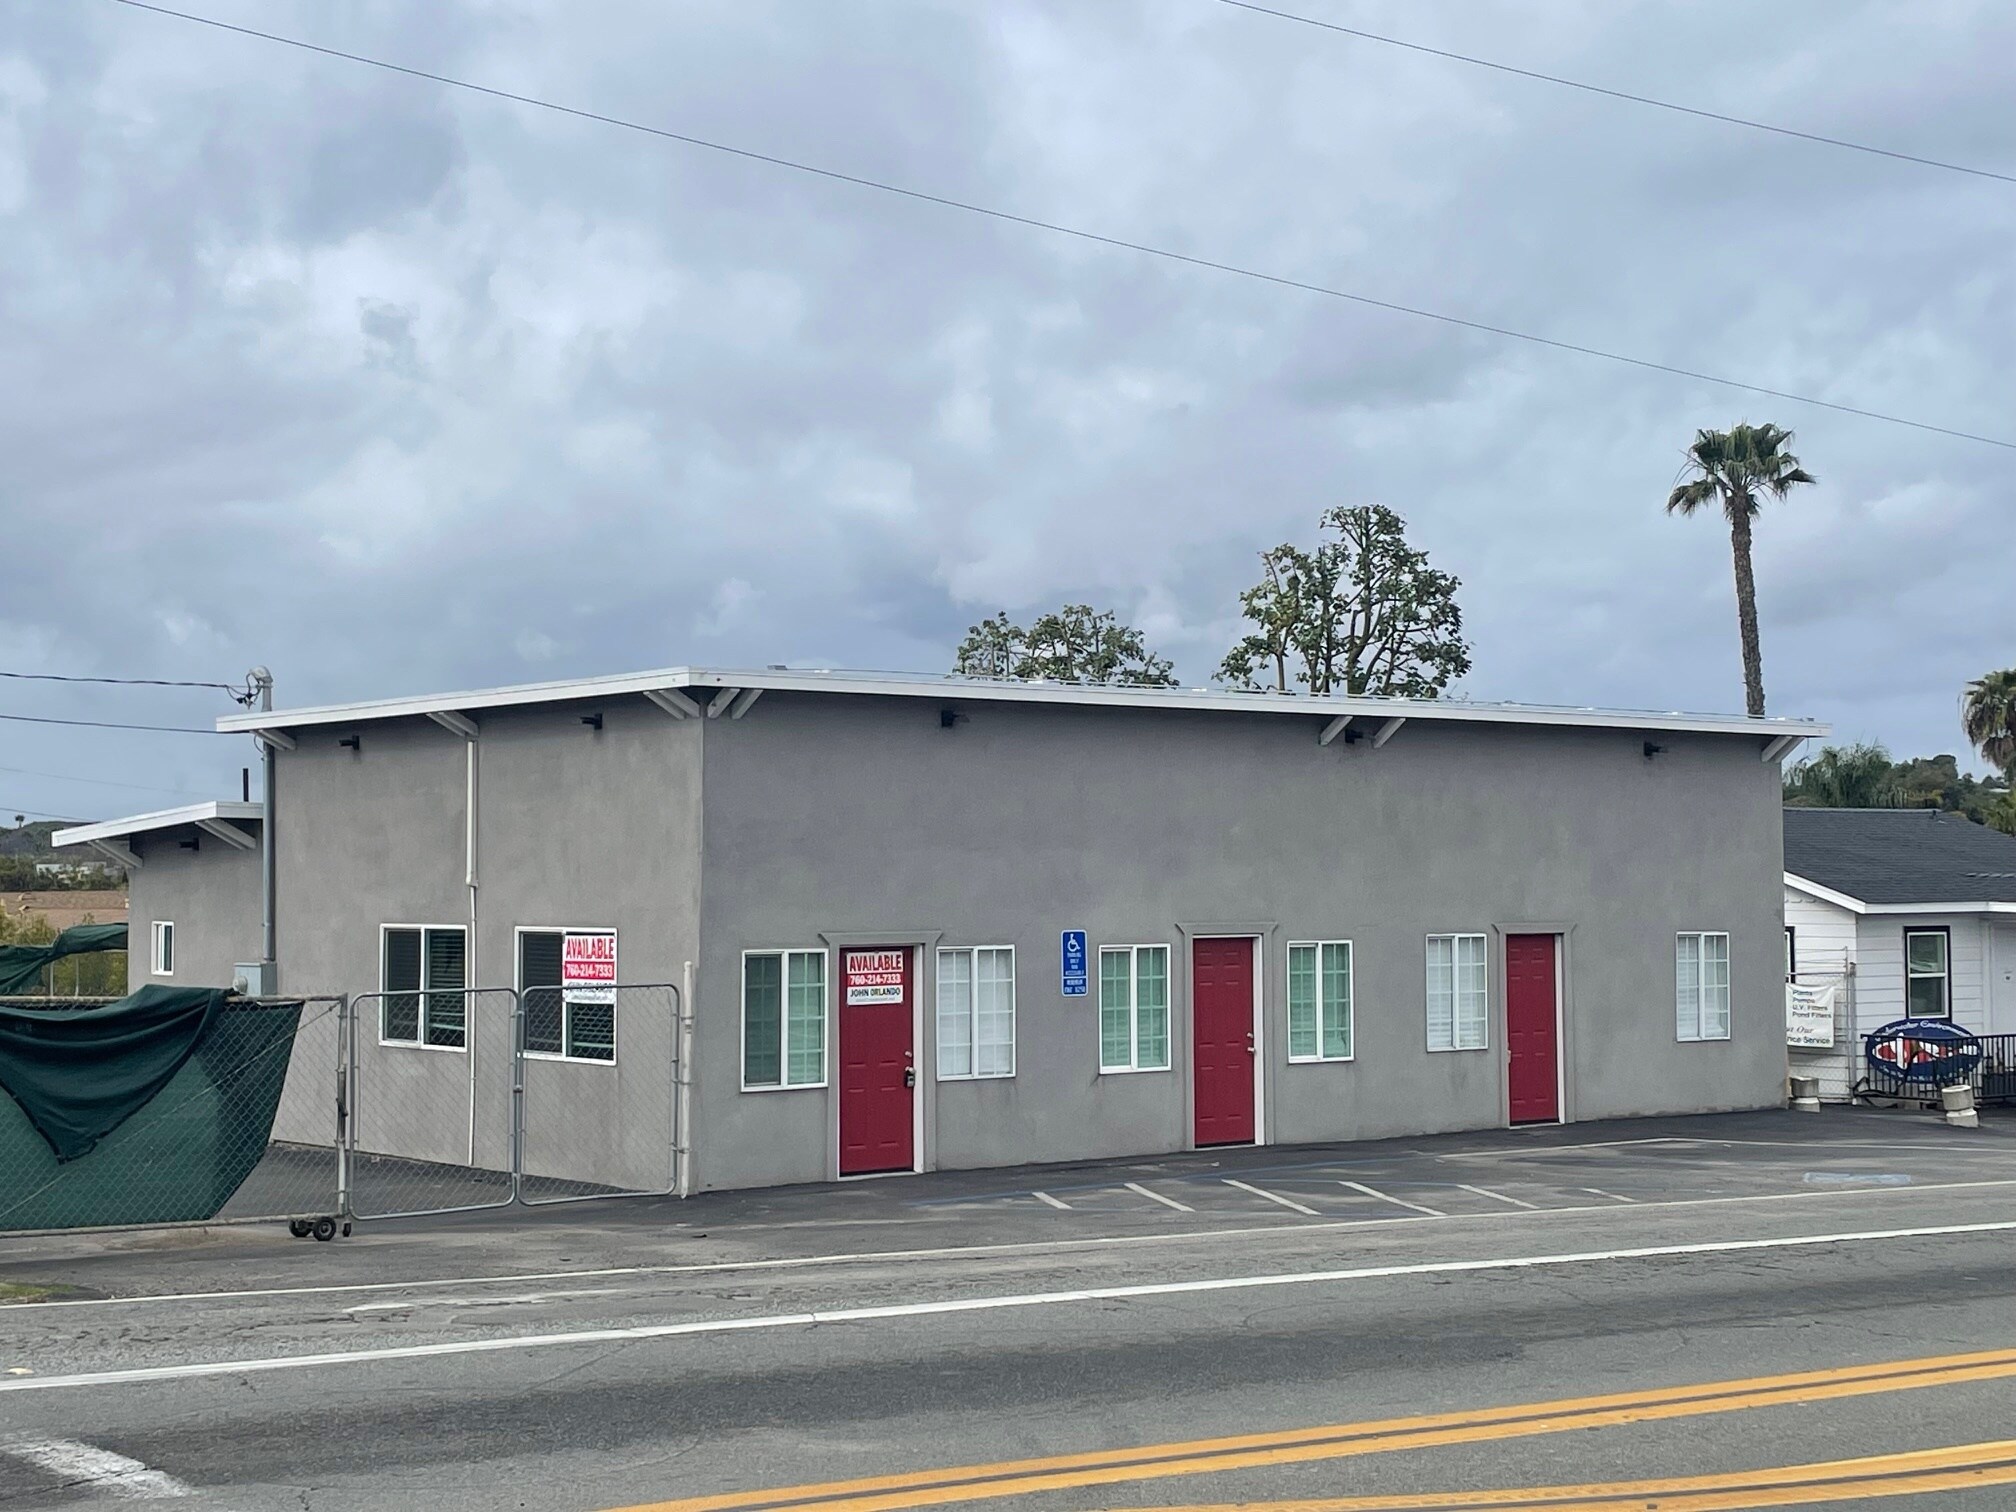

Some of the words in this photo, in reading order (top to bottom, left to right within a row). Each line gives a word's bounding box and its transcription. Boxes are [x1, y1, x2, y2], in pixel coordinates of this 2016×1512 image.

[566, 938, 614, 959] AVAILABLE
[850, 955, 901, 971] AVAILABLE
[566, 964, 613, 977] 760-214-7333
[850, 974, 901, 985] 760-214-7333
[850, 989, 869, 998] JOHN
[870, 987, 901, 997] ORLANDO
[1803, 1036, 1830, 1044] Service
